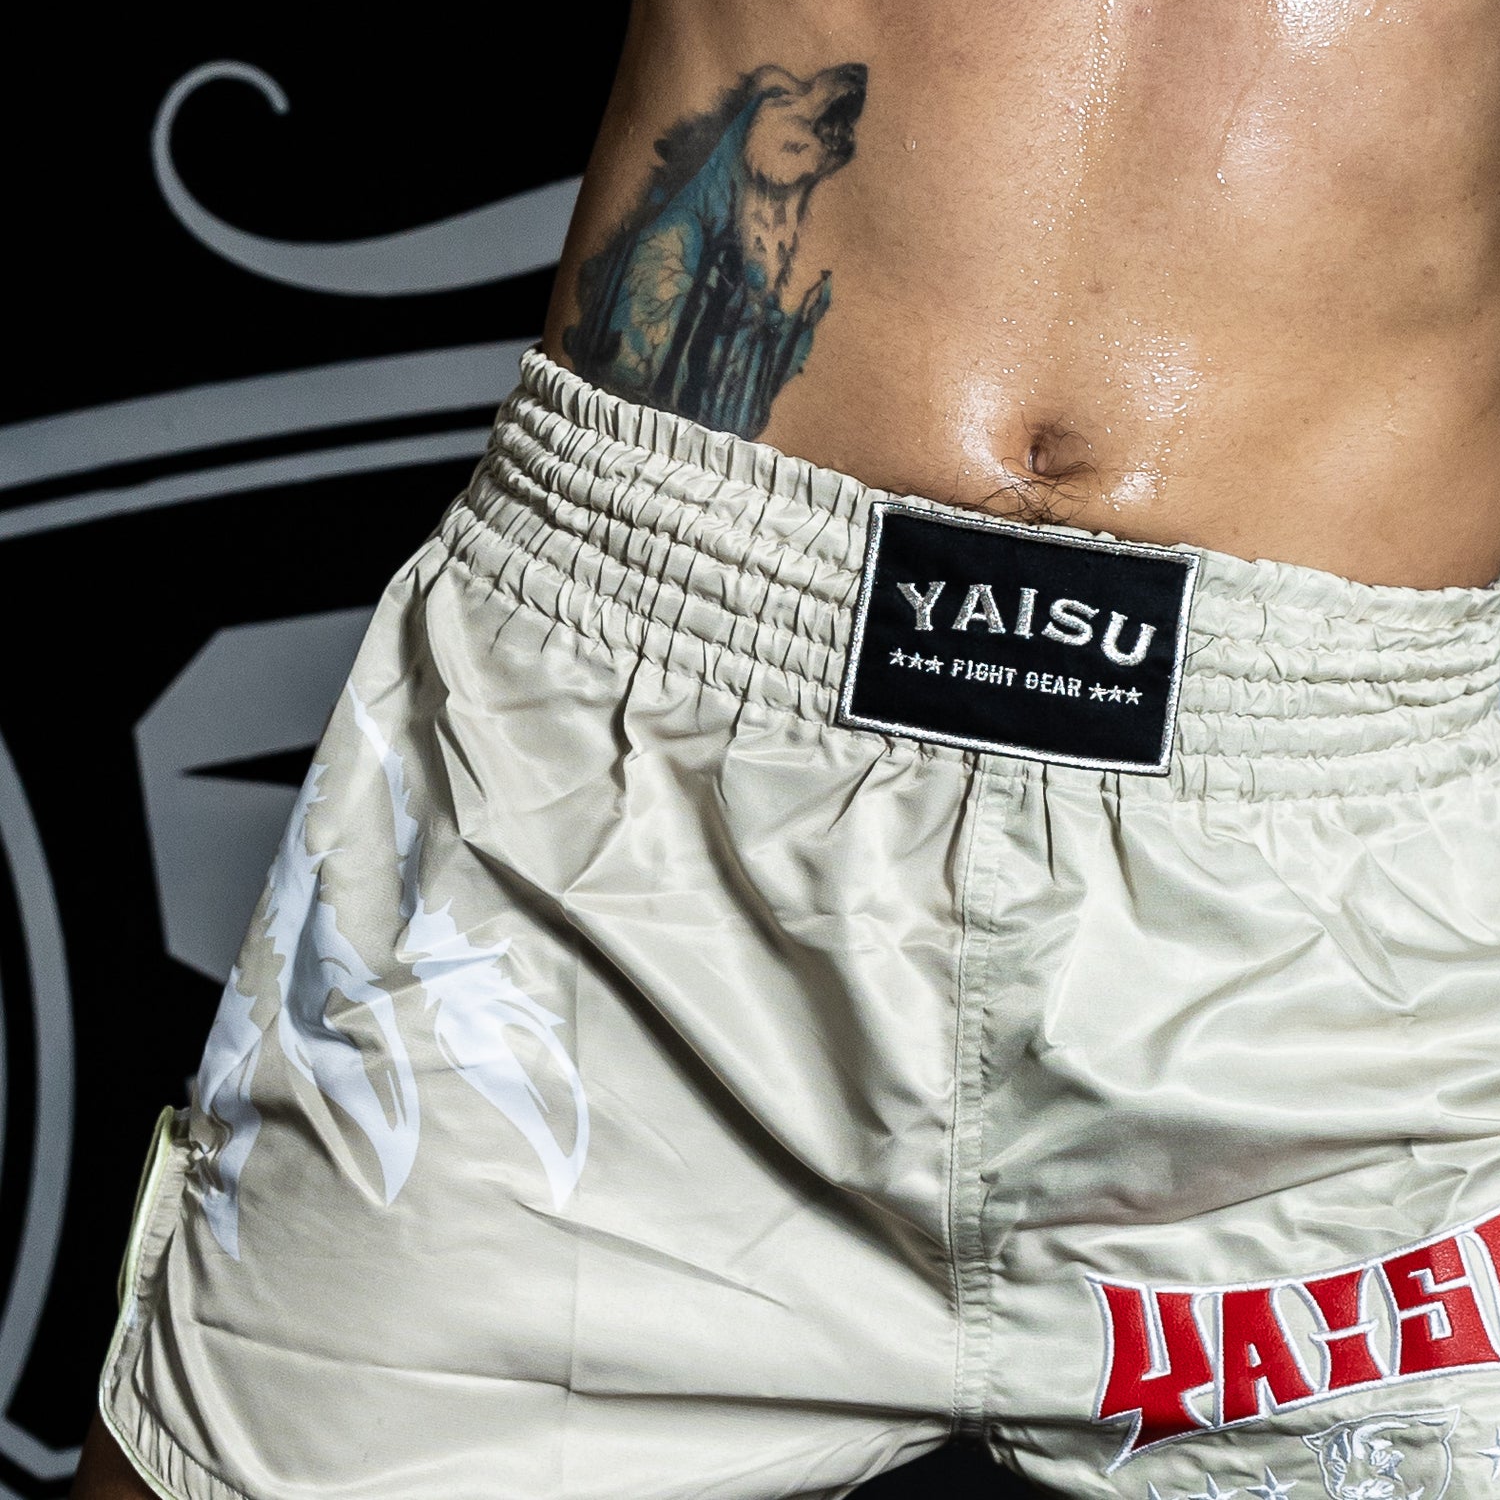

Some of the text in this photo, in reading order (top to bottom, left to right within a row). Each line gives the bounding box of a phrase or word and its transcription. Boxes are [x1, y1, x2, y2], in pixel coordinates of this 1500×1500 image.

[896, 580, 1157, 666] YAISU
[950, 658, 1082, 698] FIGHT GEAR
